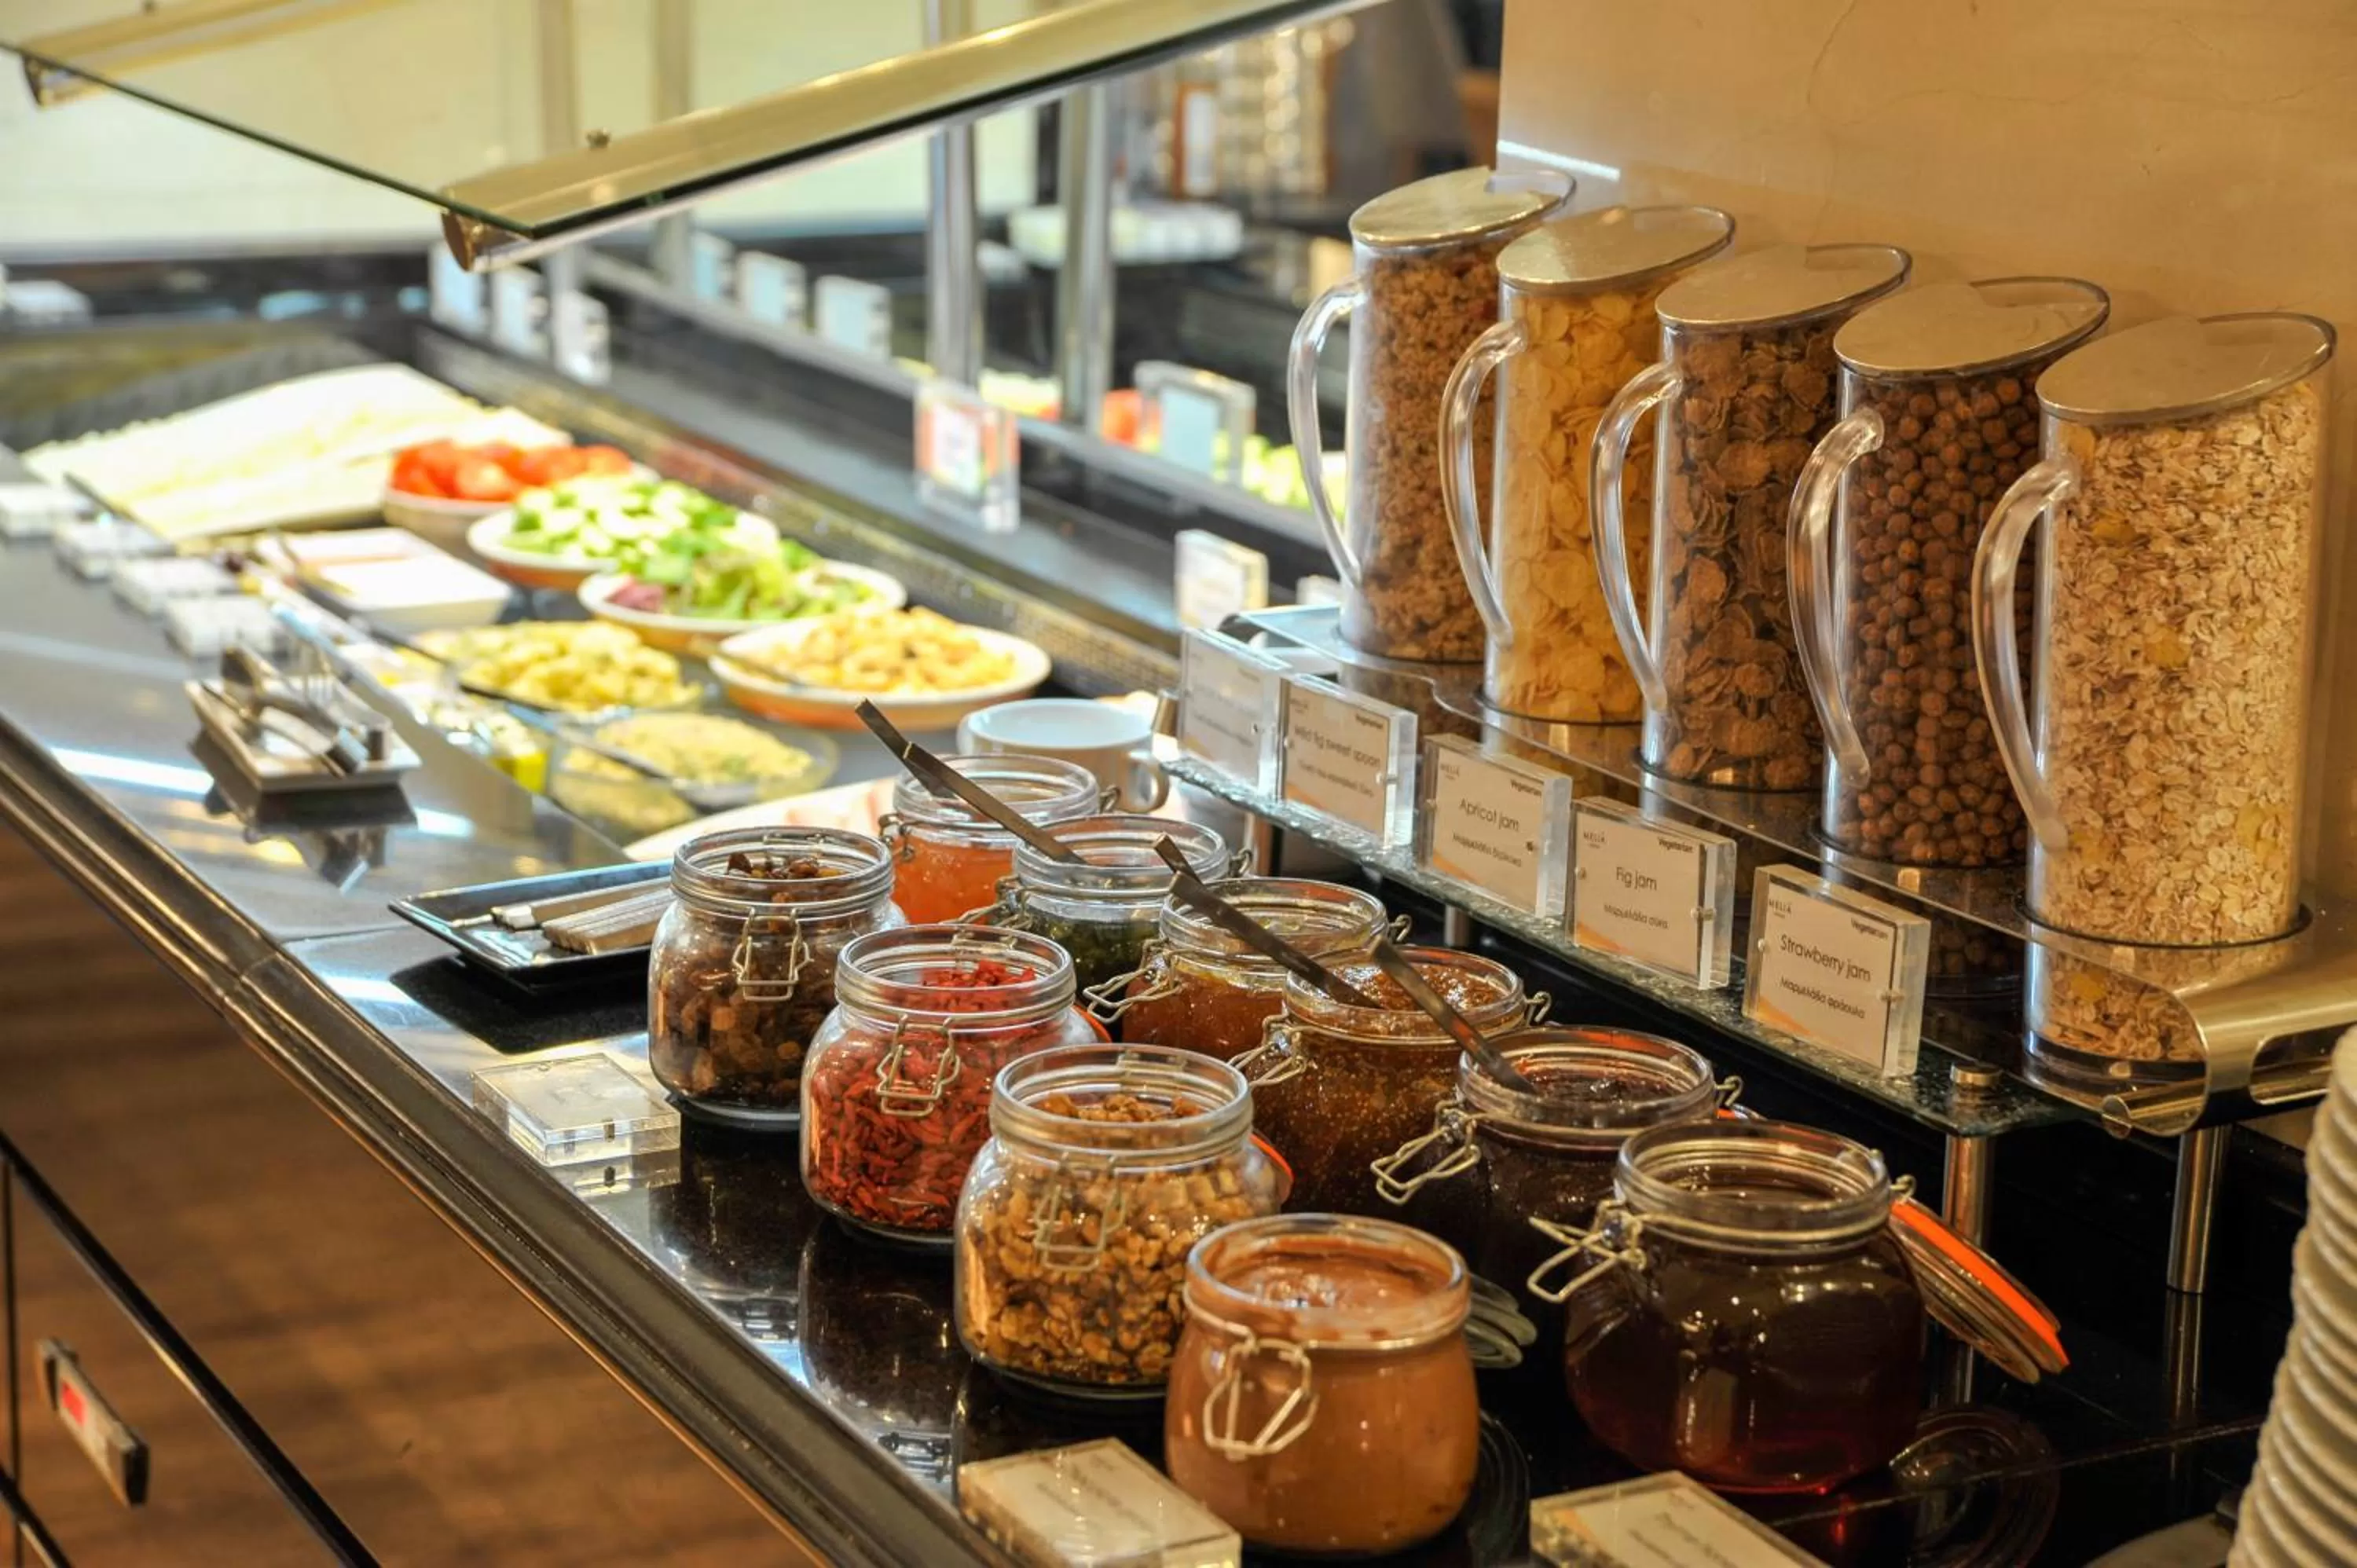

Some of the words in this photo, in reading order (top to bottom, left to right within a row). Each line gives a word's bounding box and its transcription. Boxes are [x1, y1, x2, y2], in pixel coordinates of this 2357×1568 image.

[1459, 797, 1497, 824] Apricot
[1498, 811, 1519, 831] jam
[1658, 837, 1694, 853] Vegetarian
[1615, 866, 1633, 888] Fig
[1634, 870, 1658, 891] jam
[1780, 932, 1845, 976] Strawberry
[1846, 958, 1871, 982] jam
